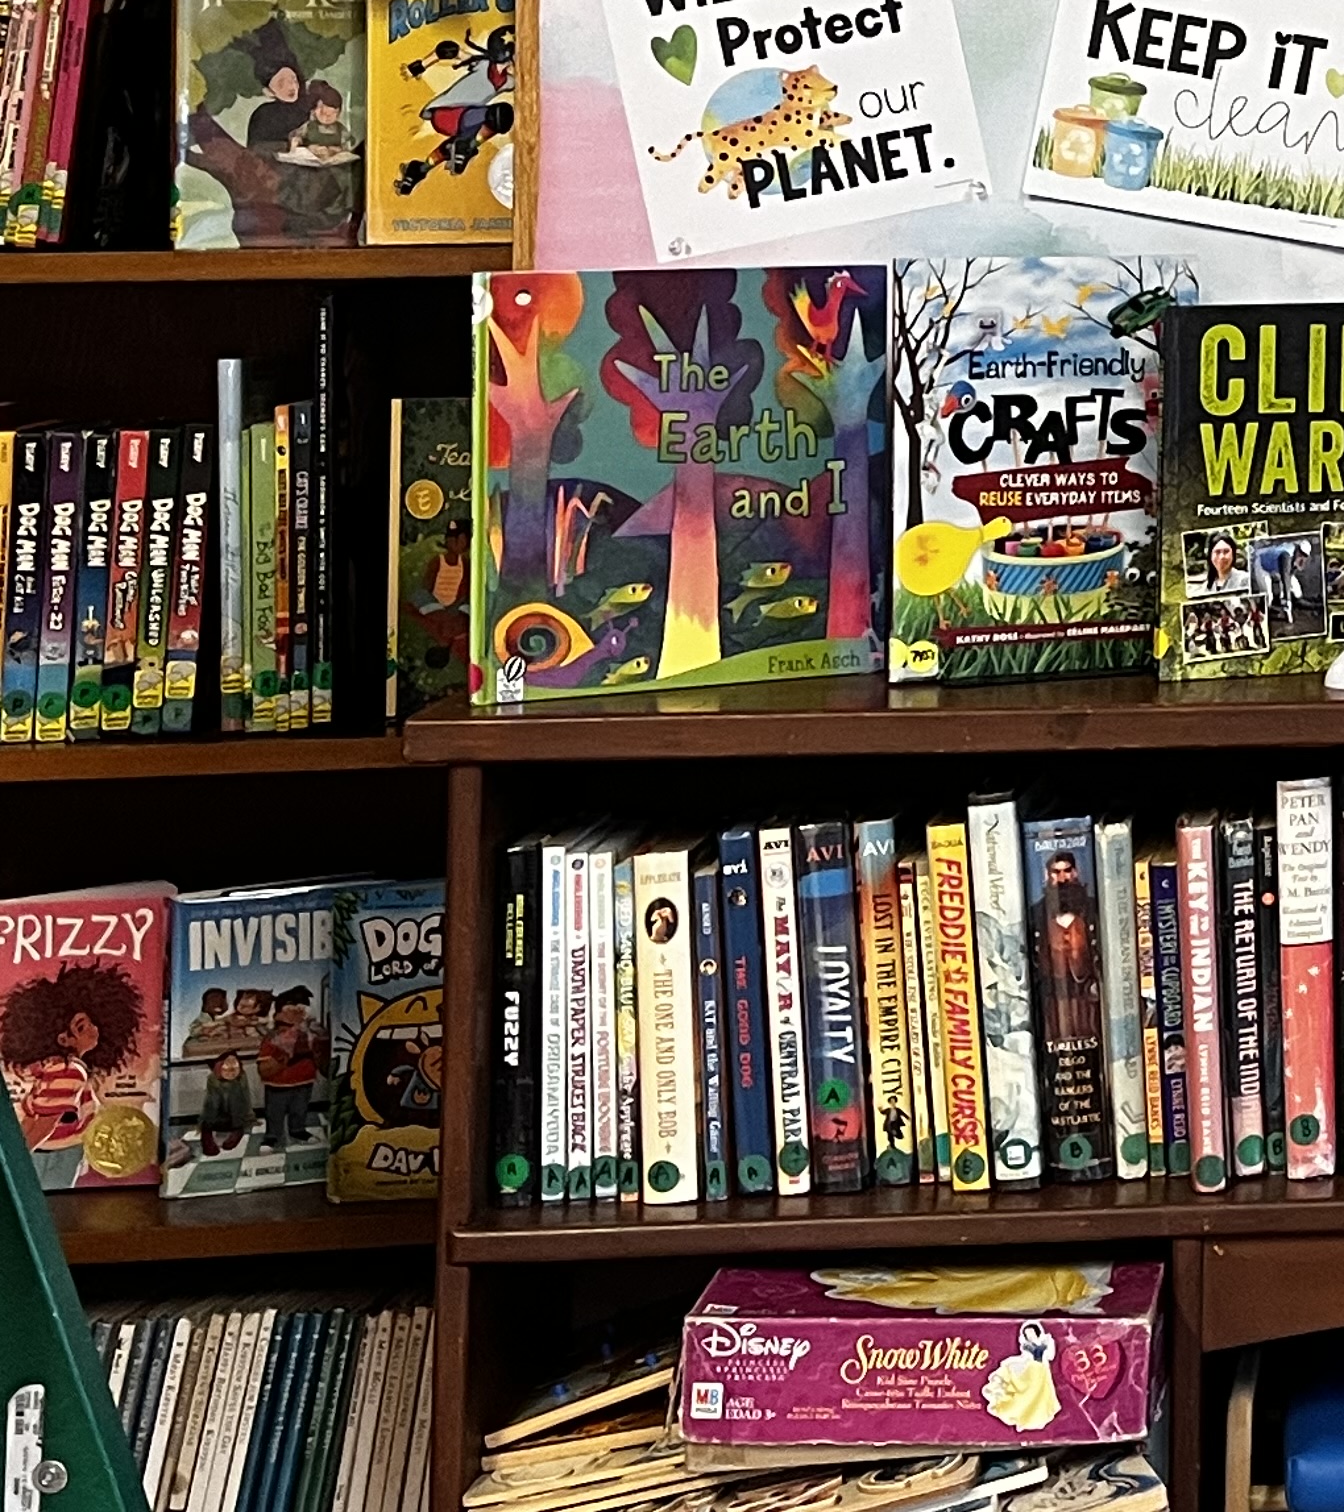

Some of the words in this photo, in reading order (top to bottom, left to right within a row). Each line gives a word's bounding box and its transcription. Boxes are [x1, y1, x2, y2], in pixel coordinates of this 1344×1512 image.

[860, 80, 925, 118] our
[740, 124, 956, 209] PLANET.
[653, 352, 731, 393] The
[967, 350, 1146, 384] Earth-Friendly
[657, 408, 818, 465] Earth
[948, 388, 1147, 466] CRAFTS
[730, 484, 810, 519] and
[826, 460, 848, 515] I
[999, 472, 1051, 489] CLEVER
[1053, 472, 1096, 487] WAYS
[1099, 471, 1119, 485] TO
[150, 498, 173, 531] DOG
[979, 490, 1022, 507] REUSE
[1025, 491, 1097, 506] EVERYDAY
[1100, 489, 1141, 505] ITEMS
[1197, 502, 1248, 517] Fourteen
[1251, 500, 1305, 514] Scientists
[1309, 500, 1330, 512] and
[16, 502, 40, 536] DOG
[16, 538, 36, 571] MAN
[150, 534, 169, 566] MAN
[767, 656, 817, 675] Frank
[819, 651, 861, 671] Asch
[806, 843, 844, 863] AVI
[872, 893, 894, 931] LOST
[936, 857, 968, 966] FREDDIE
[363, 916, 442, 963] DOG
[874, 934, 894, 955] IN
[654, 968, 673, 1000] THE
[875, 958, 897, 988] THE
[503, 991, 520, 1066] FUZZY
[655, 1001, 674, 1031] ONE
[877, 991, 901, 1055] EMPIRE
[944, 983, 975, 1072] FAMILY
[656, 1033, 675, 1065] AND
[657, 1067, 676, 1108] ONLY
[880, 1058, 903, 1096] CITY
[659, 1110, 677, 1139] BOB
[948, 1076, 979, 1146] CURSE
[841, 1334, 920, 1384] Snow
[919, 1337, 990, 1370] White
[1073, 1345, 1107, 1372] 33
[696, 1389, 719, 1406] MB
